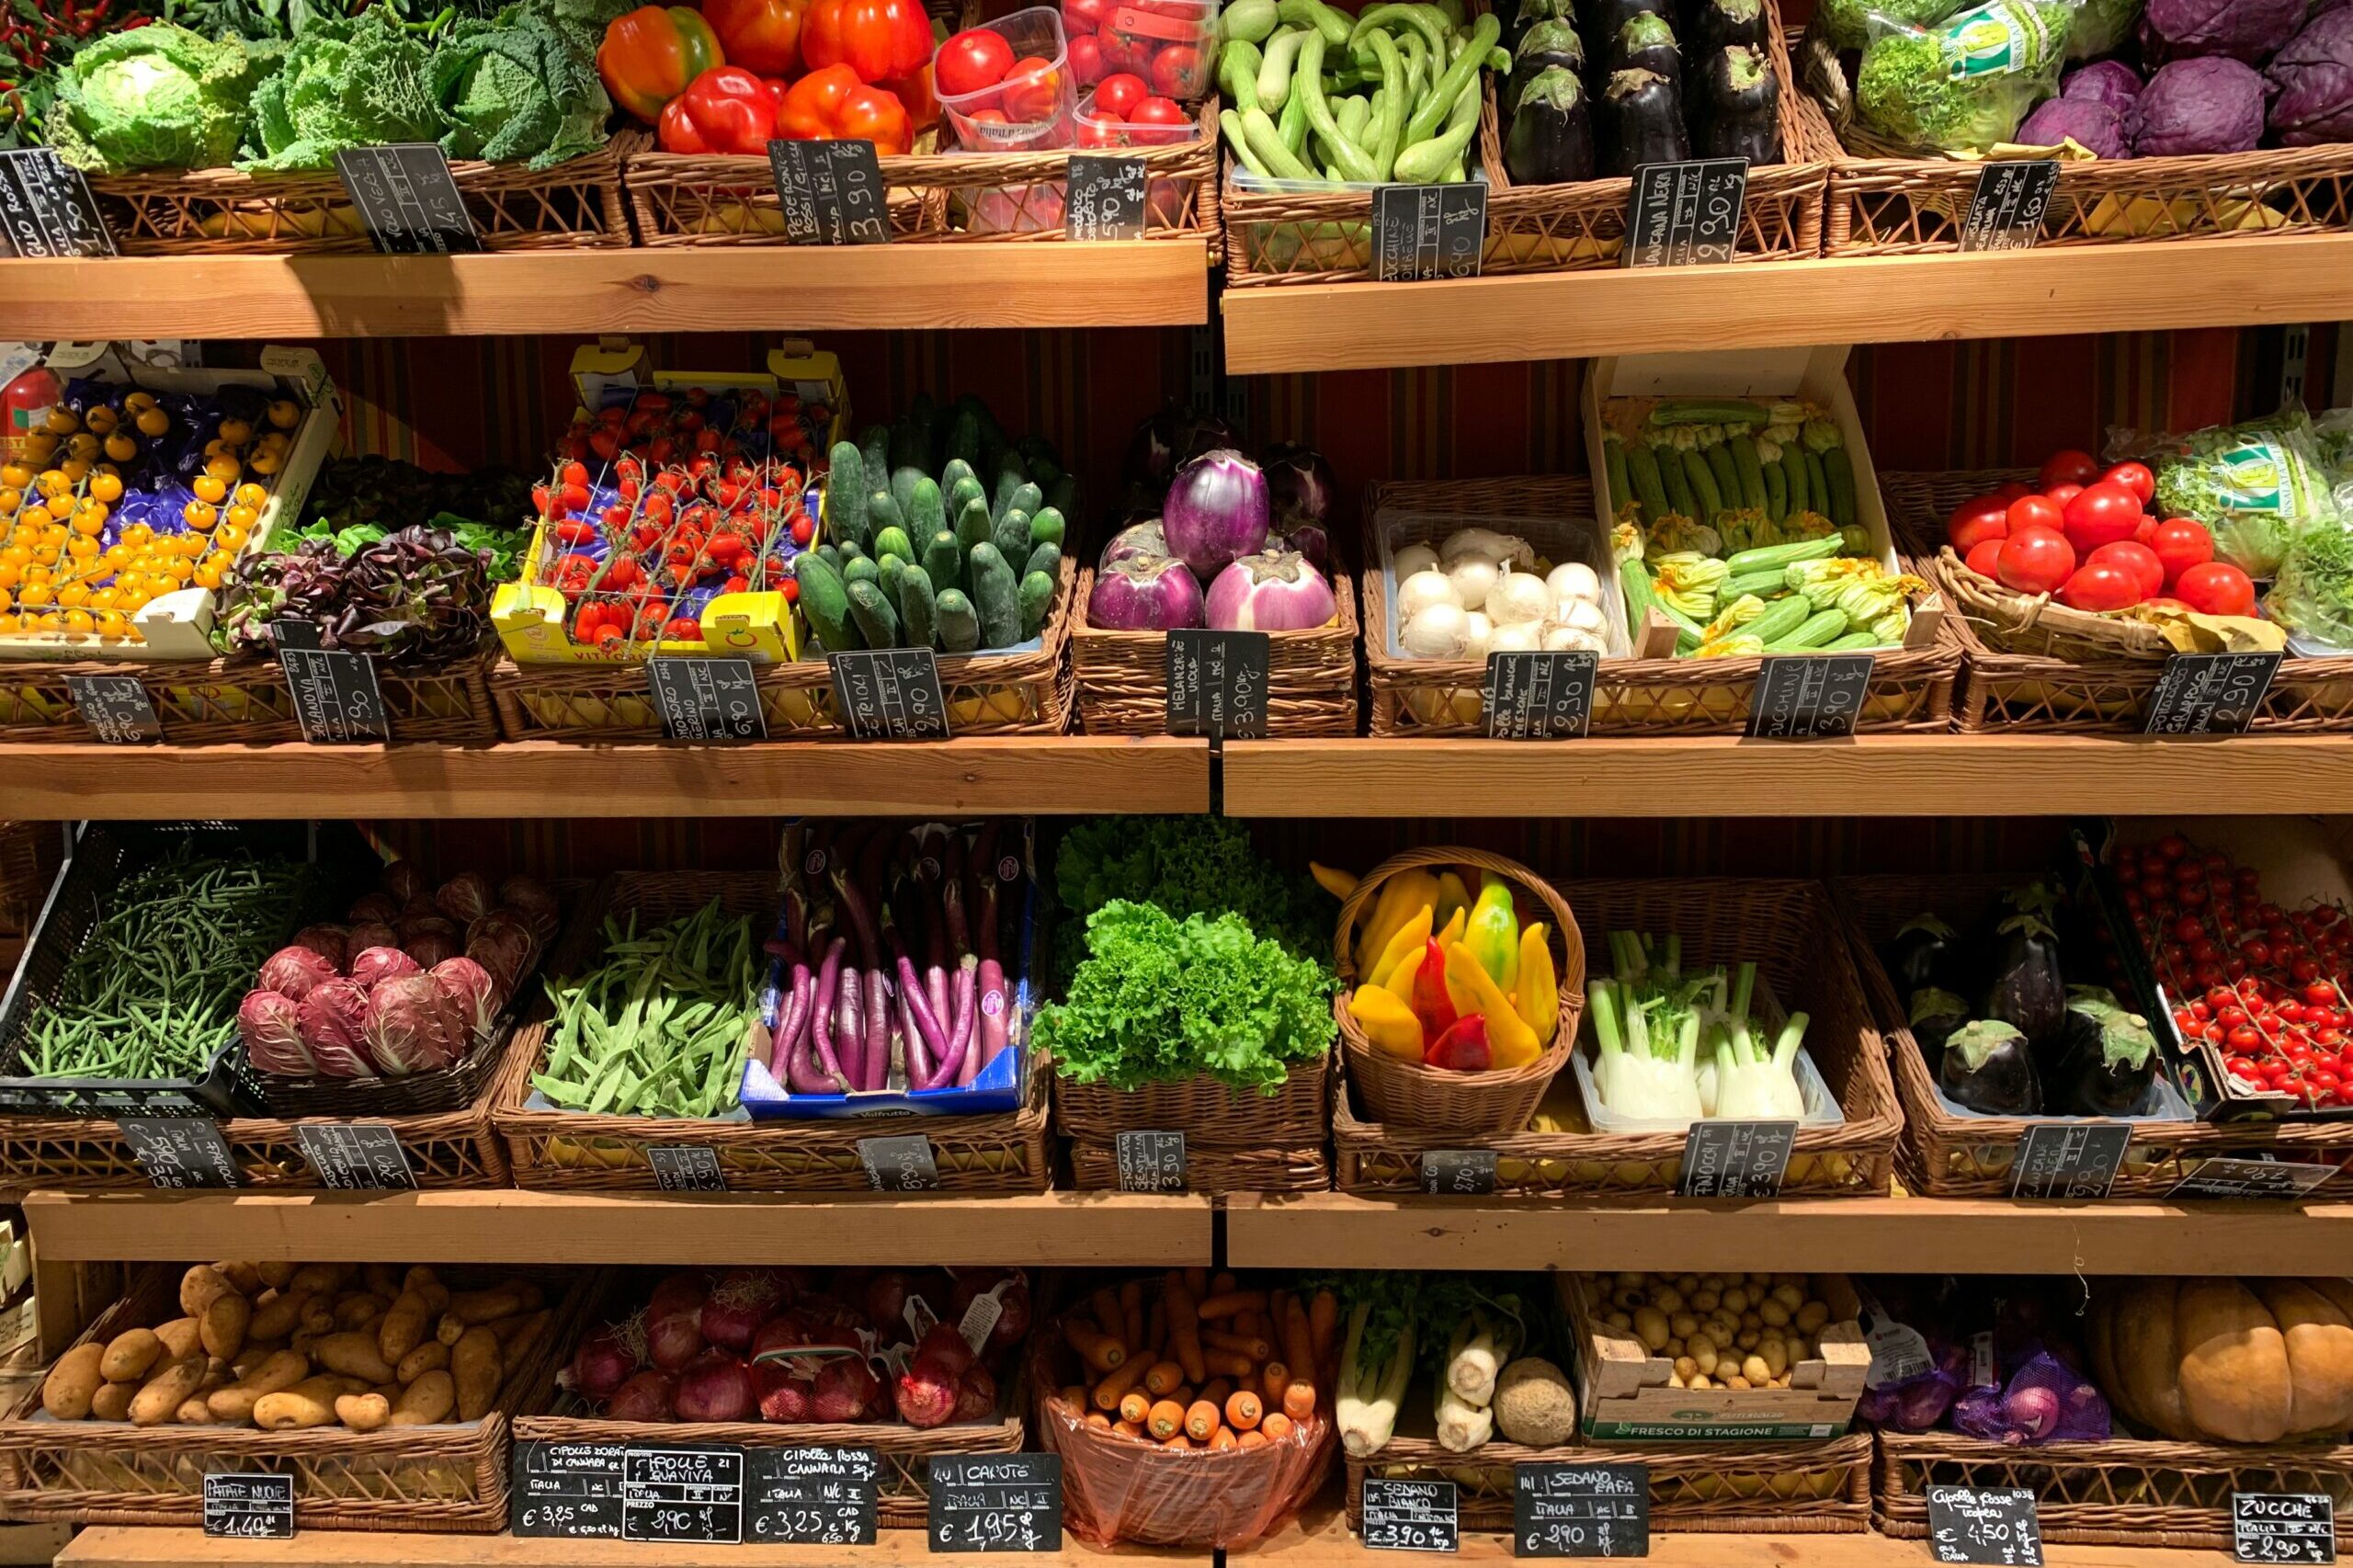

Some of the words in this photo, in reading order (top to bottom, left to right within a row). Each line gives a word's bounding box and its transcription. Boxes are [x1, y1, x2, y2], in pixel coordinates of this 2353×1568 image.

[301, 679, 325, 736] ALANOVA
[1631, 1427, 1684, 1436] FRESCO
[1551, 1471, 1611, 1486] SEDANO
[206, 1480, 246, 1498] PATATE
[1383, 1483, 1438, 1497] SEDANO
[1388, 1497, 1430, 1509] BIANCO
[2240, 1500, 2313, 1518] ZUCCHE
[522, 1508, 536, 1526] €
[755, 1516, 770, 1534] €
[938, 1524, 953, 1542] €
[1936, 1528, 1957, 1543] €
[1967, 1524, 2009, 1546] 4,50
[2240, 1523, 2276, 1532] ITALIA
[1526, 1533, 1540, 1550] €
[2238, 1542, 2255, 1558] €
[2261, 1536, 2300, 1562] 2,90
